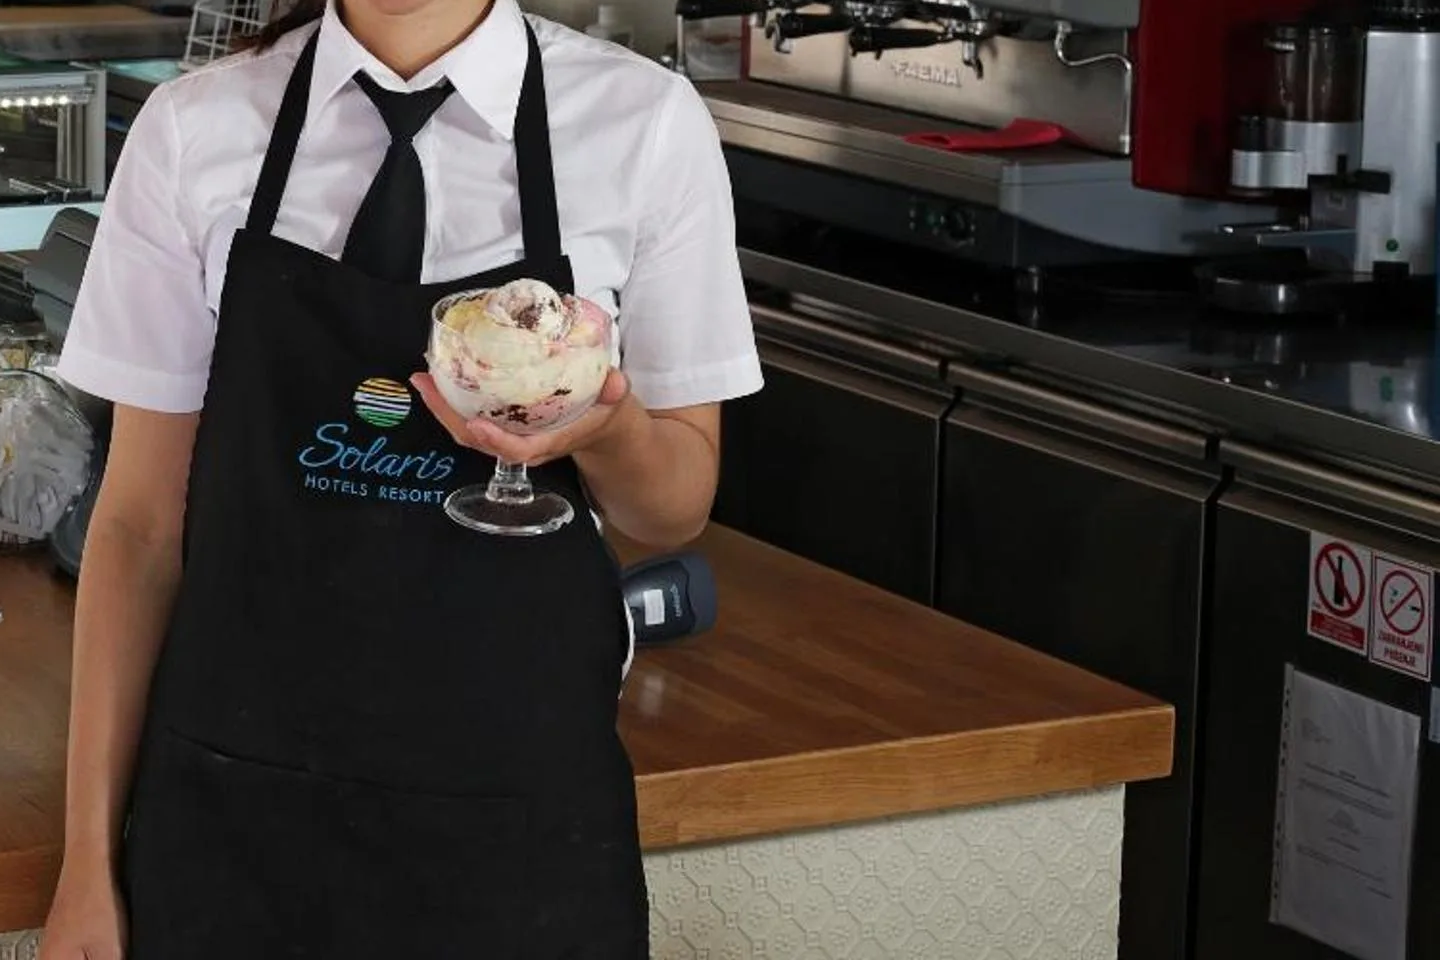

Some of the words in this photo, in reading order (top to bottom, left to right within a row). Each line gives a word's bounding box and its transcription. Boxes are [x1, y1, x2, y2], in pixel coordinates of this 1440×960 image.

[298, 423, 455, 481] Solaris
[304, 473, 368, 497] HOTELS
[378, 487, 444, 504] RESORT
